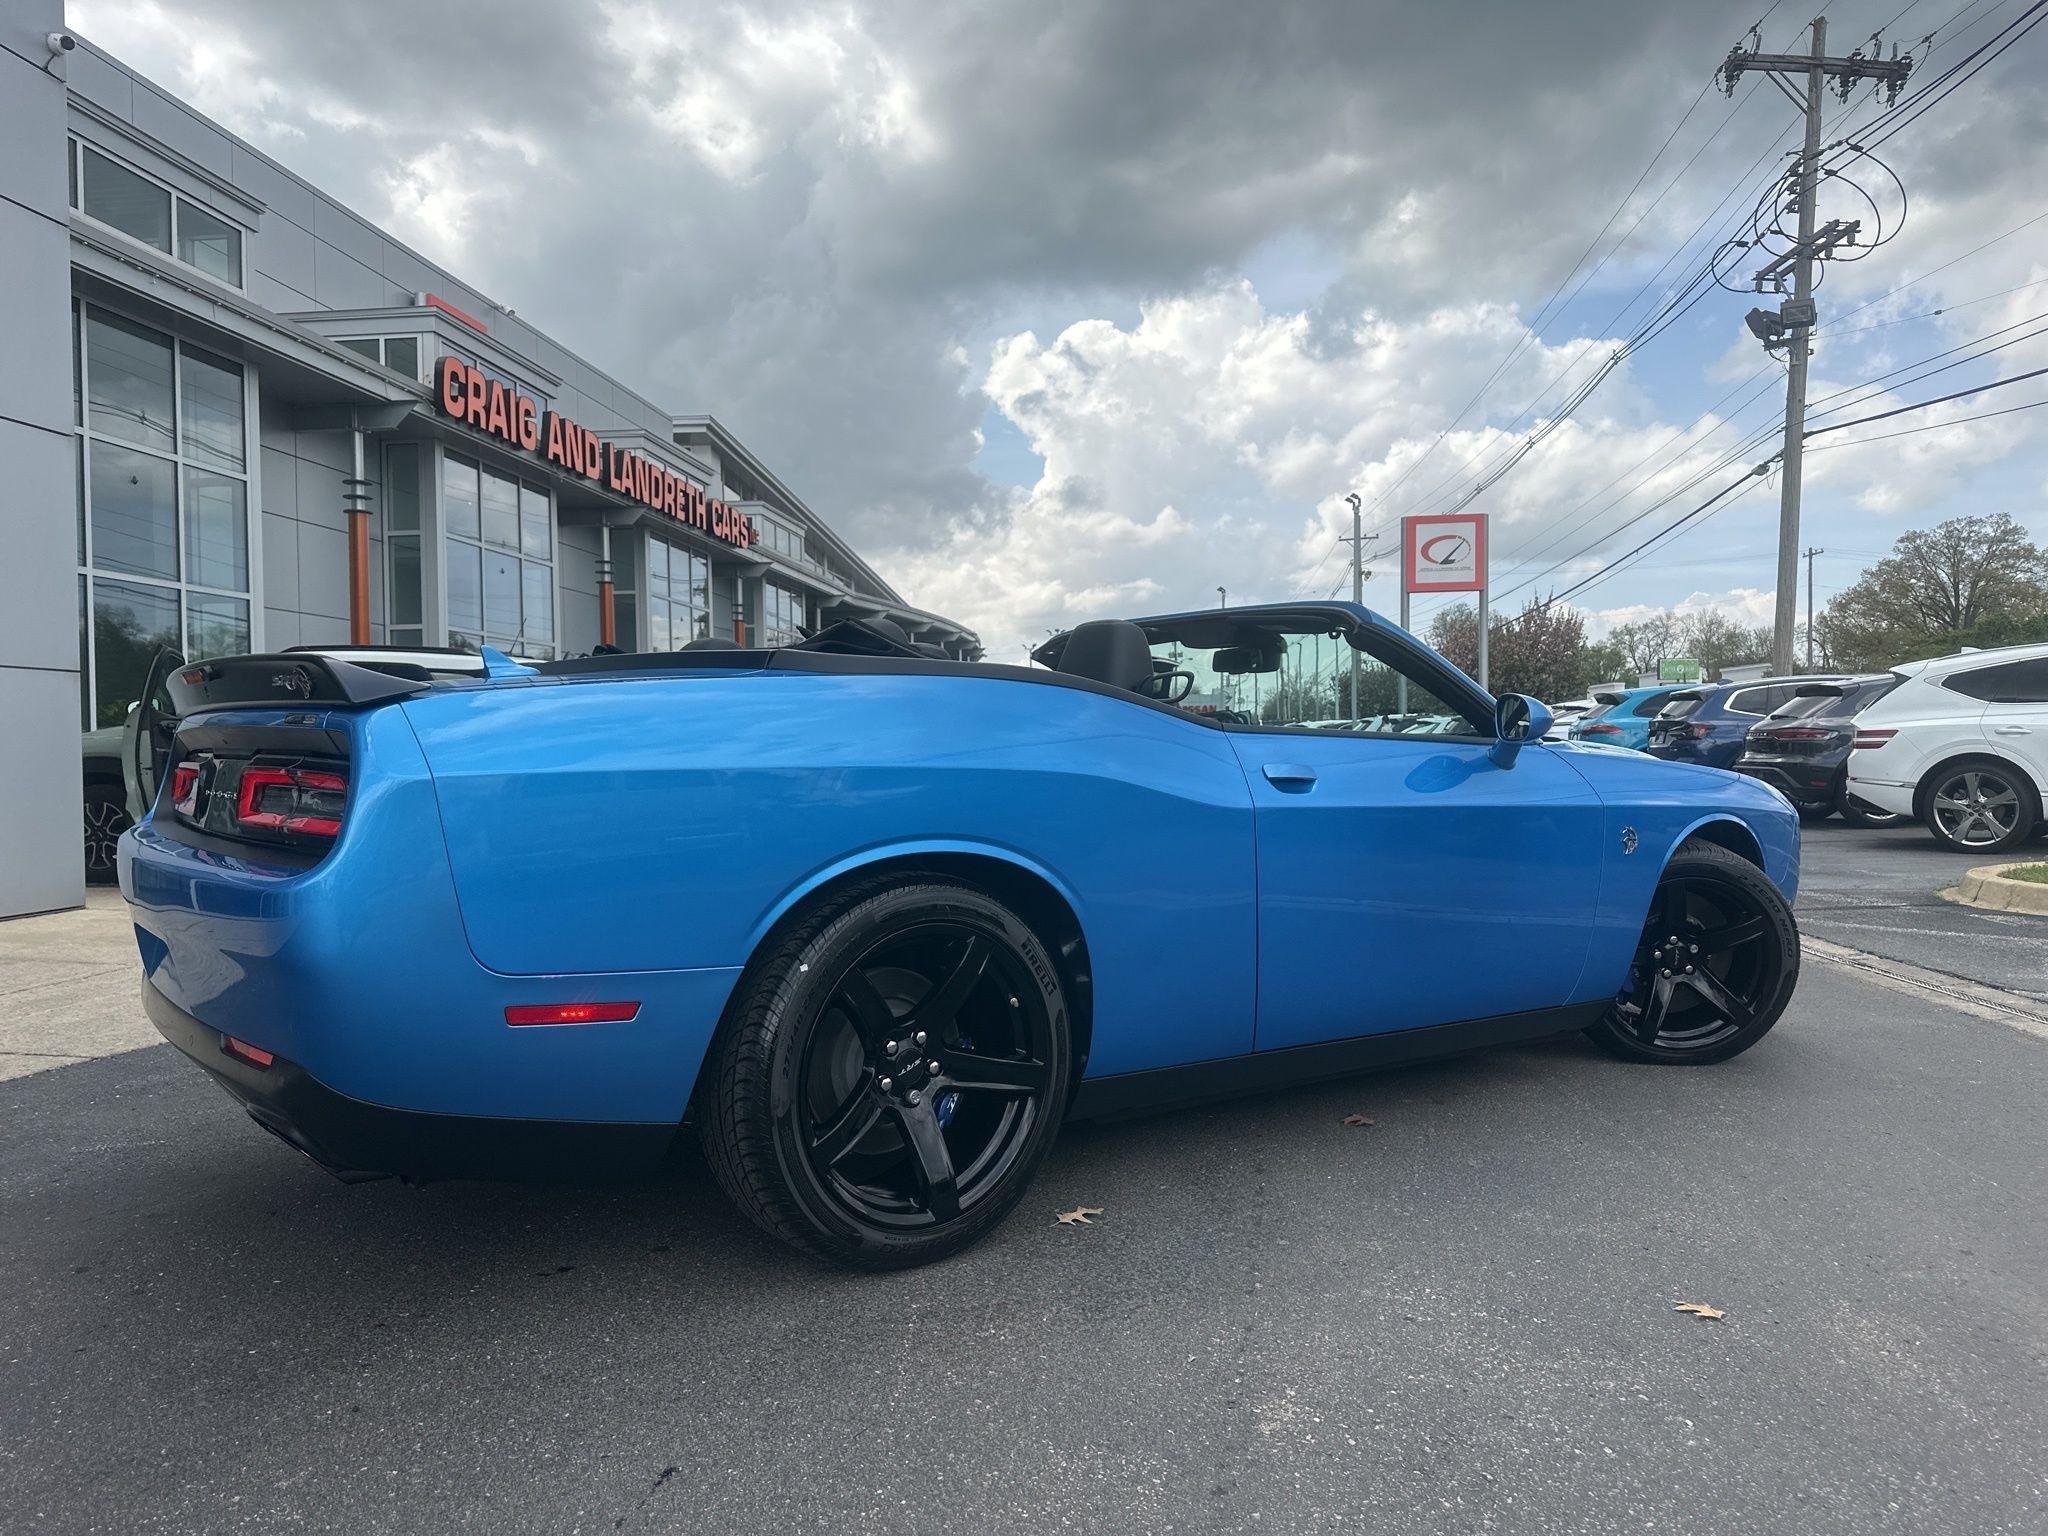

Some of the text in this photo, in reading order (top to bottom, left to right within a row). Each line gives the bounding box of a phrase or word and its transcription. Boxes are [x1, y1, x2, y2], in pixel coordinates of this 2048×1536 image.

[438, 356, 749, 549] CRAIG AND LANDRETH CARS
[1020, 936, 1057, 997] PIRELLI
